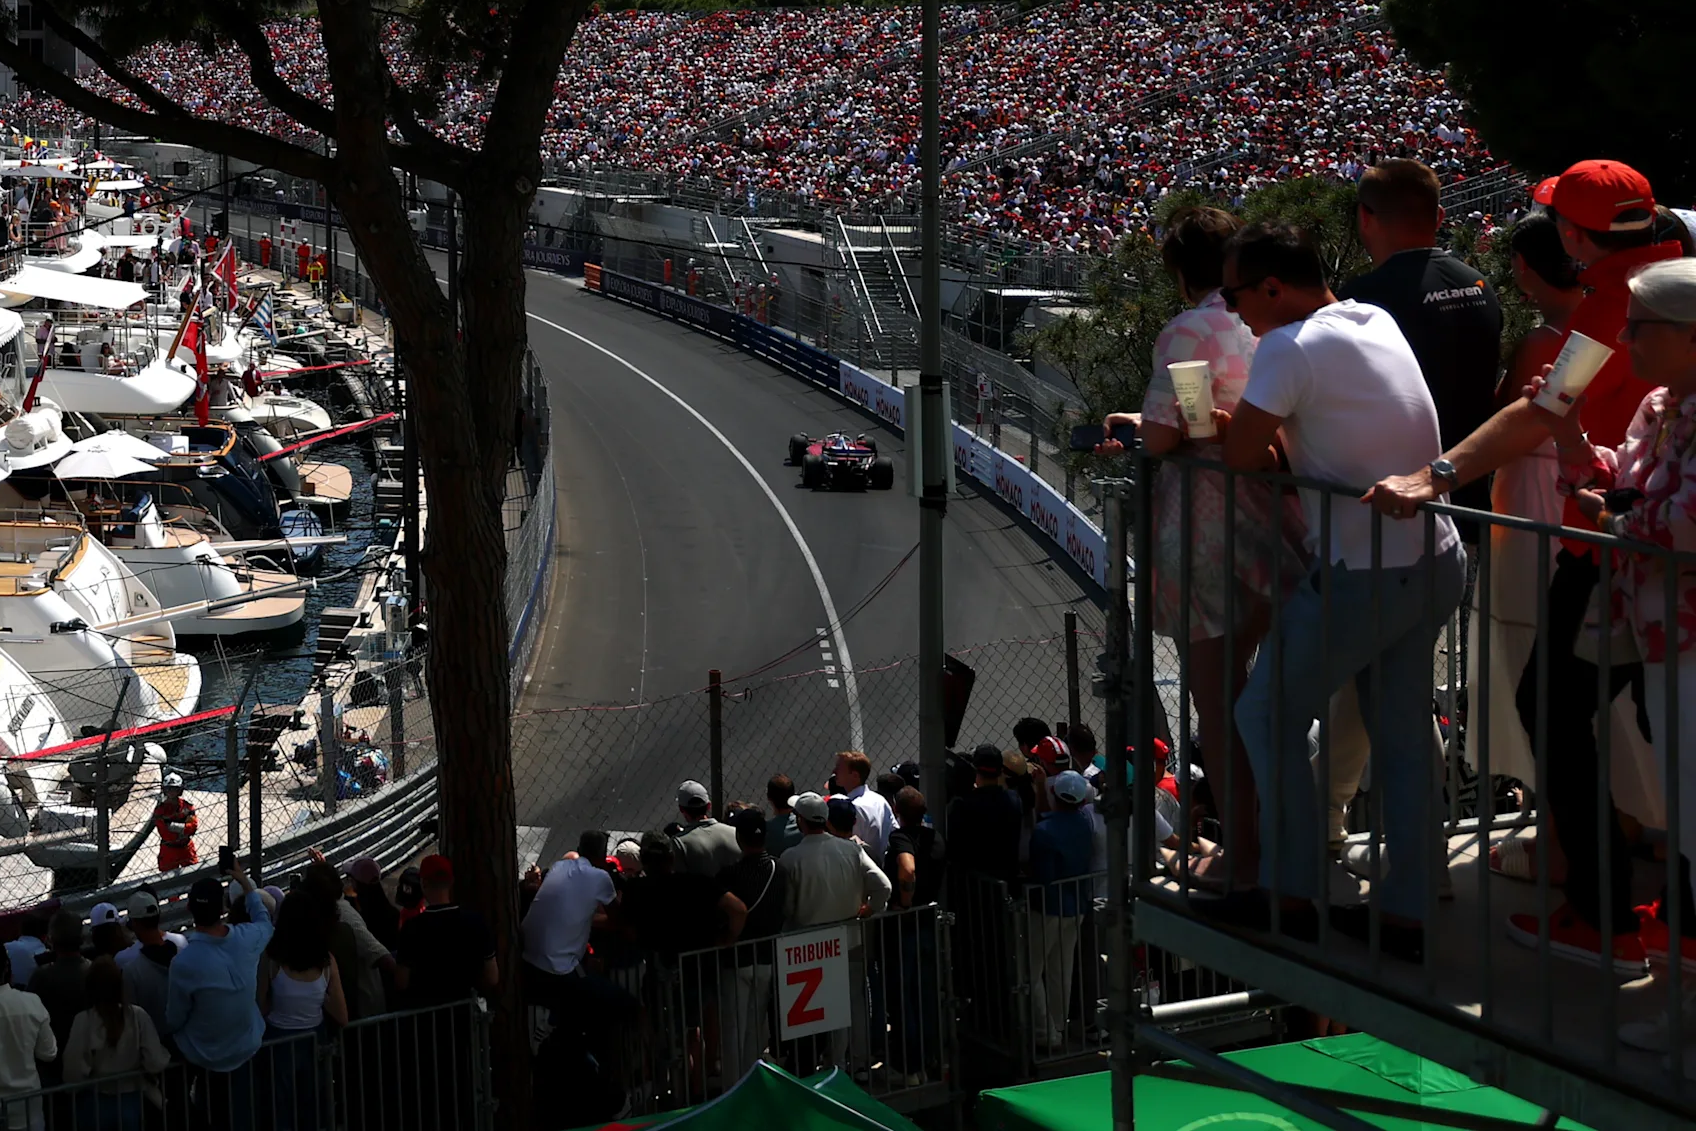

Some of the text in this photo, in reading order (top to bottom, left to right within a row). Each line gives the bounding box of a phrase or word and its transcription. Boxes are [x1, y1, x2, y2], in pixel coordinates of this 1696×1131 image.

[1422, 285, 1483, 304] McLaren
[844, 380, 869, 405] MONACO
[876, 397, 901, 424] MONACO
[996, 472, 1023, 508] MONACO
[1031, 498, 1058, 538] MONACO
[1067, 530, 1095, 575] MONACO
[785, 938, 841, 965] TRIBUNE
[786, 966, 825, 1027] Z
